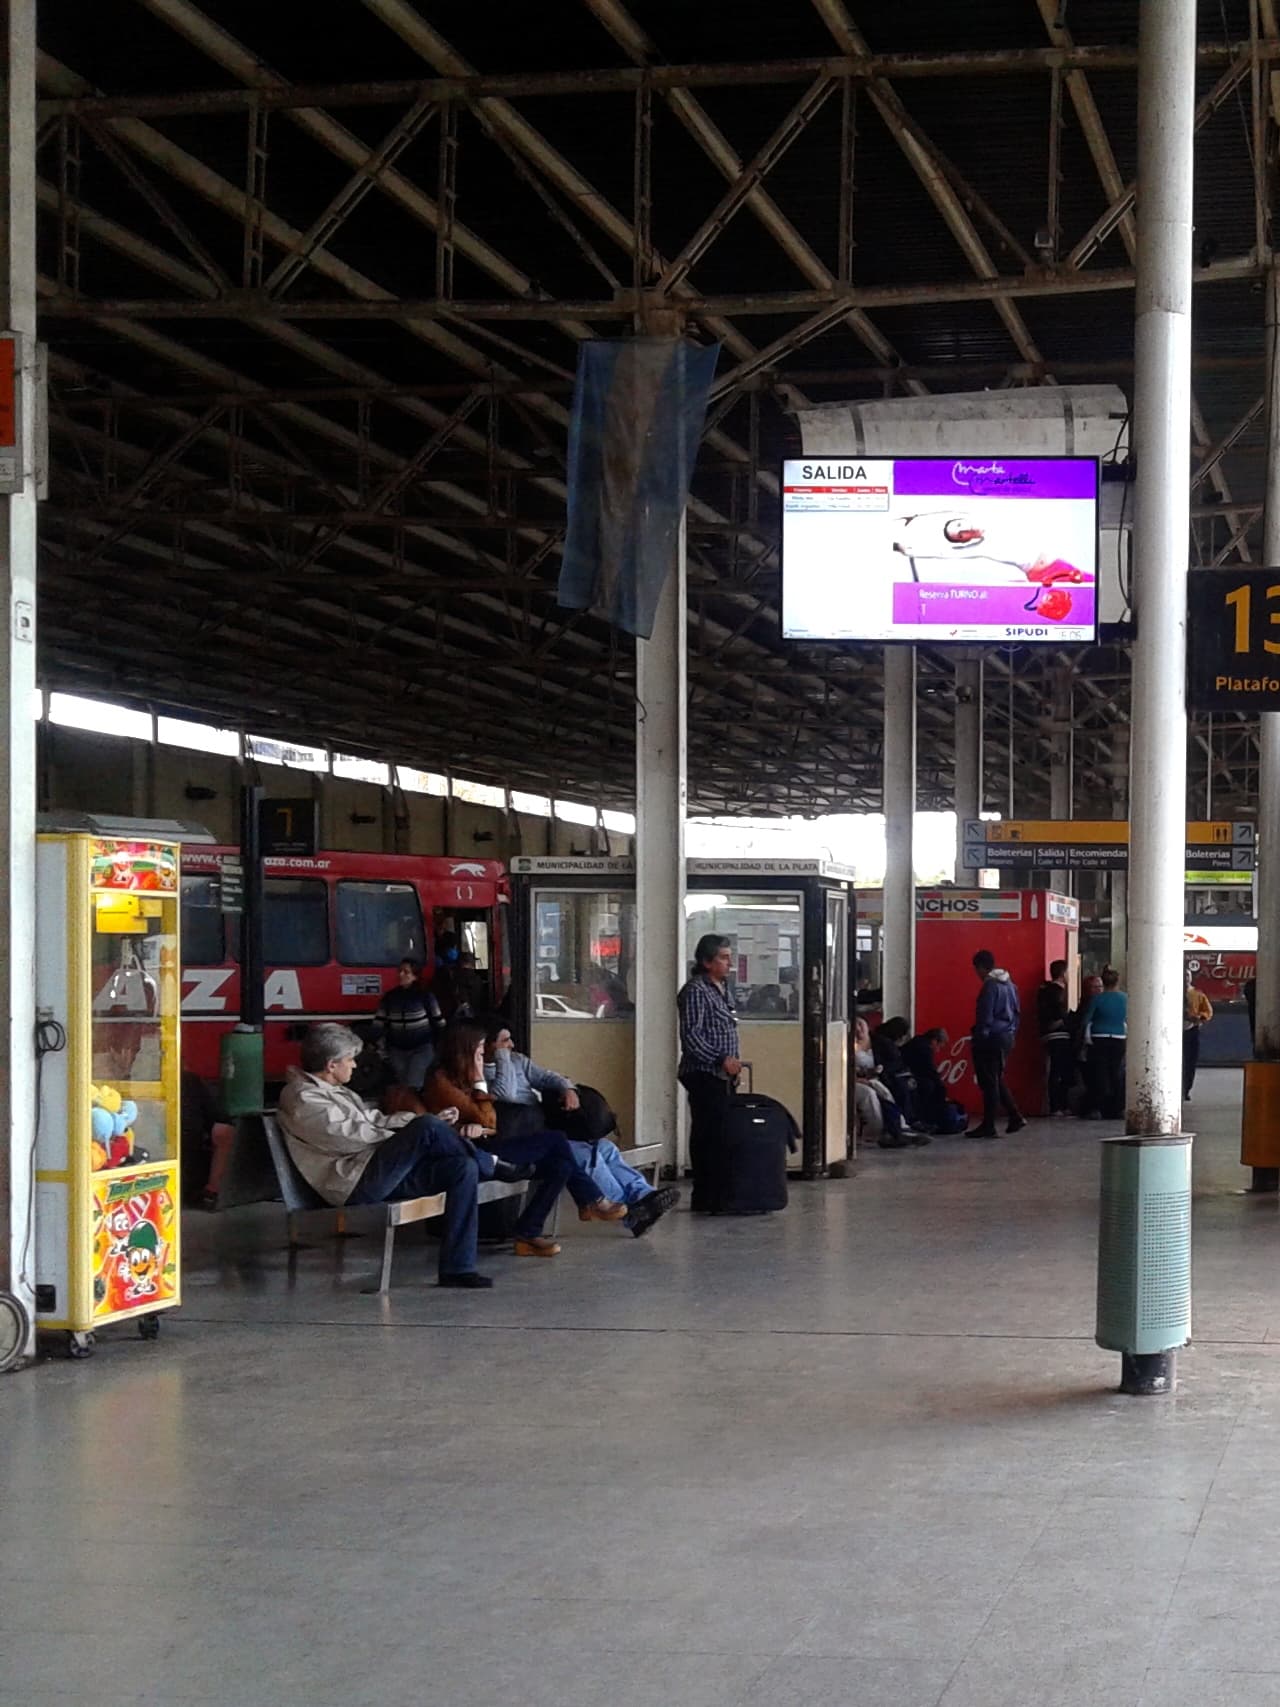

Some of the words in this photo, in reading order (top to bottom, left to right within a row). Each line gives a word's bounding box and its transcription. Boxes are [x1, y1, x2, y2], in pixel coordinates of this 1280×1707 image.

[802, 465, 867, 480] SALIDA
[1005, 628, 1048, 636] SIPUDI
[1038, 848, 1065, 857] Salida
[1070, 848, 1128, 857] Encomiendas
[537, 861, 604, 869] MUNICIPALIDAD
[608, 862, 619, 870] DE
[793, 863, 818, 871] PLATA
[915, 900, 980, 912] NCHOS
[1200, 965, 1257, 979] AGUIL
